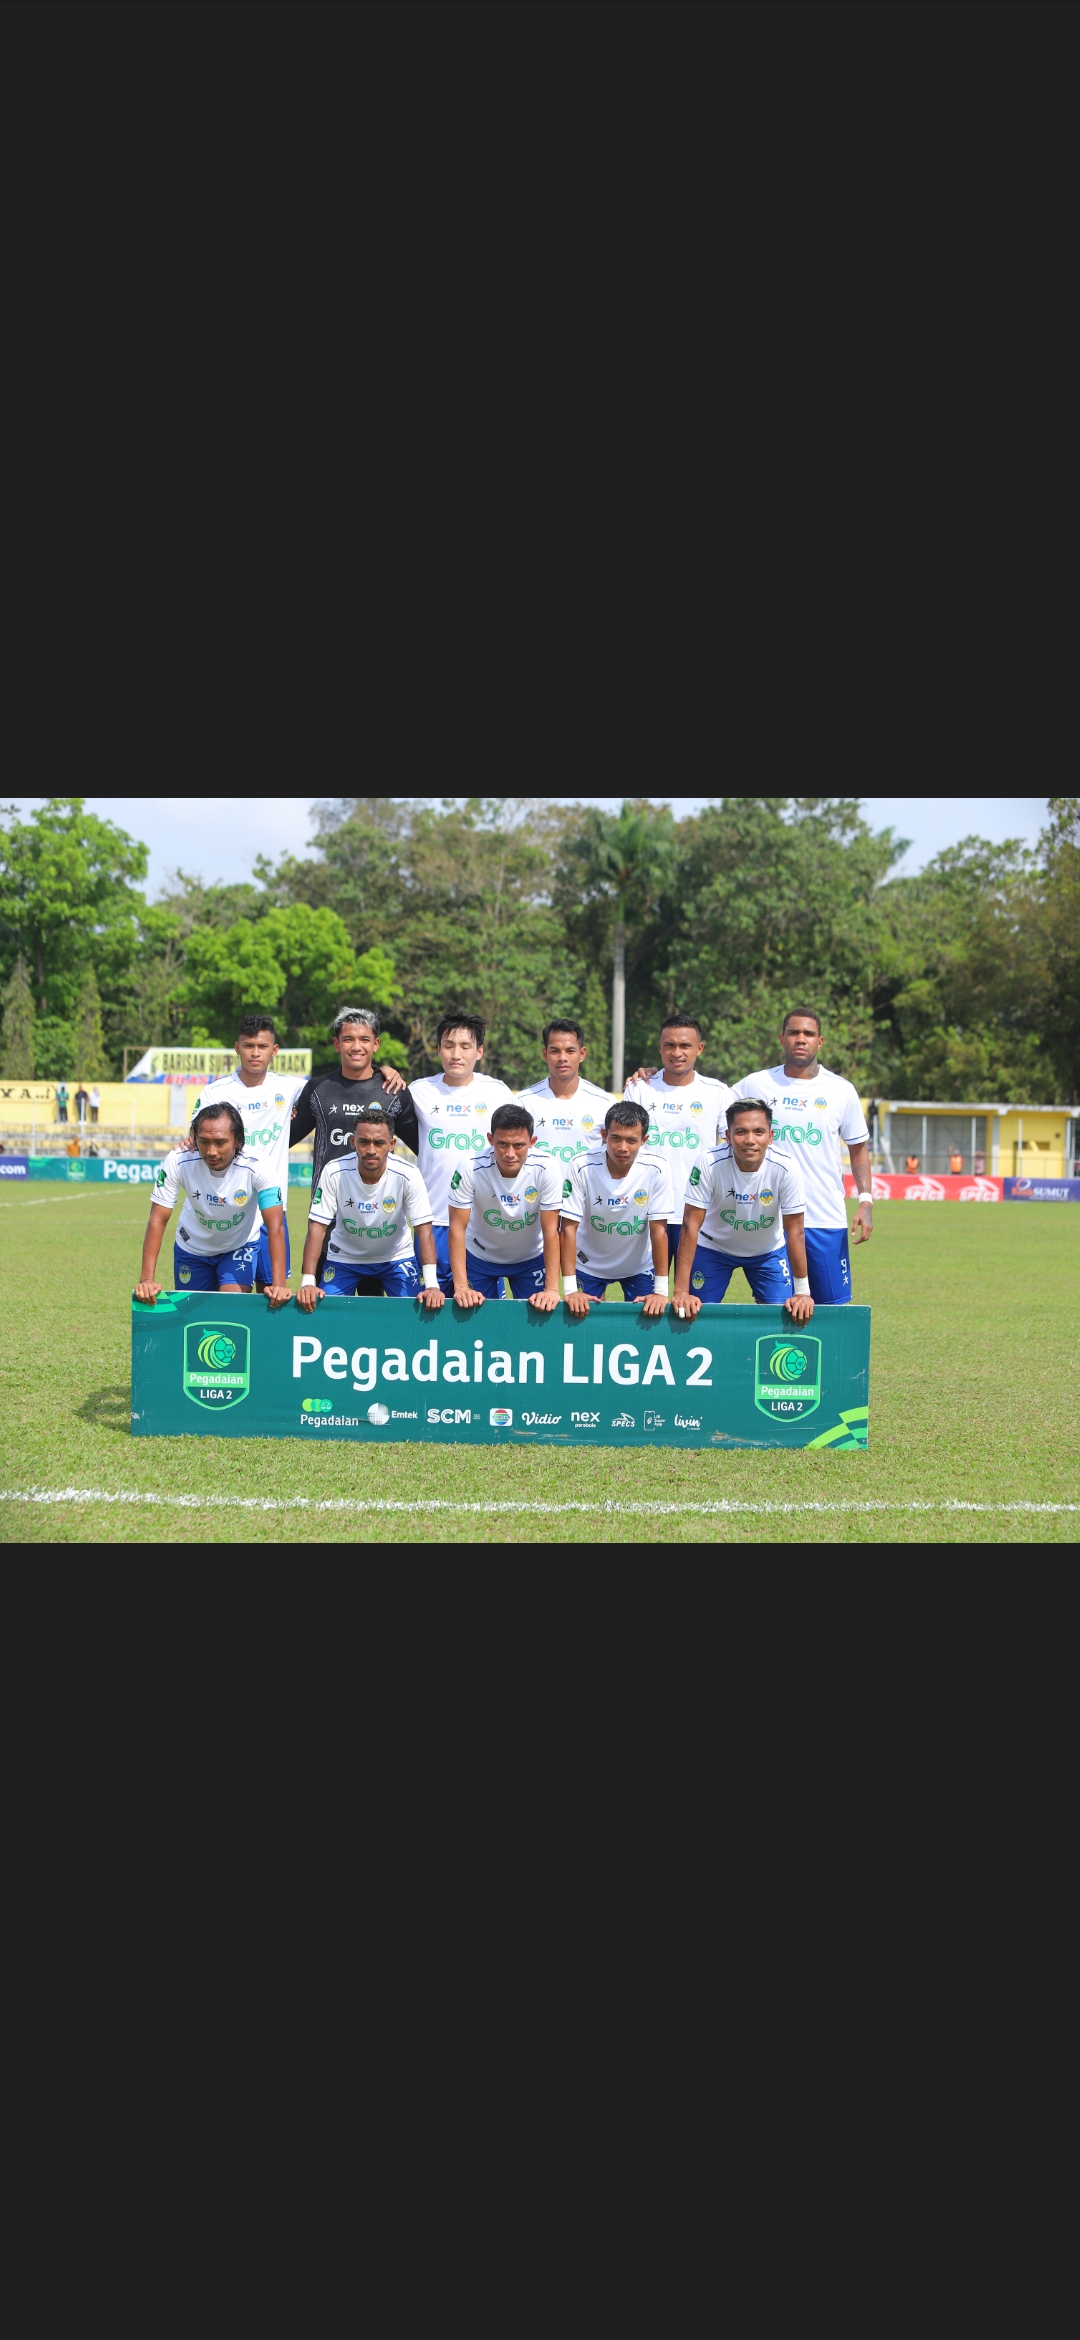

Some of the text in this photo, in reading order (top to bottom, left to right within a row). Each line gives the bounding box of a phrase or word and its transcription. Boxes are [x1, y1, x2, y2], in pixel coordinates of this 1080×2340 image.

[248, 1101, 268, 1111] nex
[342, 1103, 365, 1113] nex
[662, 1102, 683, 1111] nex
[782, 1096, 808, 1108] nex
[446, 1104, 471, 1113] nex
[552, 1118, 574, 1126] nex
[330, 1128, 355, 1146] Gr
[428, 1128, 485, 1151] Grab
[645, 1125, 700, 1150] Grab
[206, 1193, 227, 1204] nex
[500, 1194, 521, 1203] nex
[607, 1196, 629, 1206] nex
[735, 1193, 756, 1201] nex
[358, 1202, 379, 1211] nex
[194, 1209, 245, 1232] Grab
[483, 1209, 539, 1231] Grab
[590, 1215, 647, 1236] Grab
[720, 1209, 775, 1231] Grab
[342, 1218, 398, 1239] Grab
[778, 1259, 790, 1277] 8
[532, 1268, 546, 1287] 2
[291, 1335, 713, 1392] Pegadaian LIGA 2
[189, 1373, 244, 1386] Pegadaian
[200, 1389, 233, 1399] LIGA 2
[761, 1385, 815, 1398] Pegadaian
[771, 1401, 803, 1411] LIGA 2
[391, 1410, 418, 1419] Emtek
[427, 1408, 472, 1424] SCM
[521, 1411, 562, 1426] Vidio
[570, 1411, 601, 1422] nex
[300, 1414, 359, 1428] Pegadaian
[611, 1420, 636, 1428] SPECS
